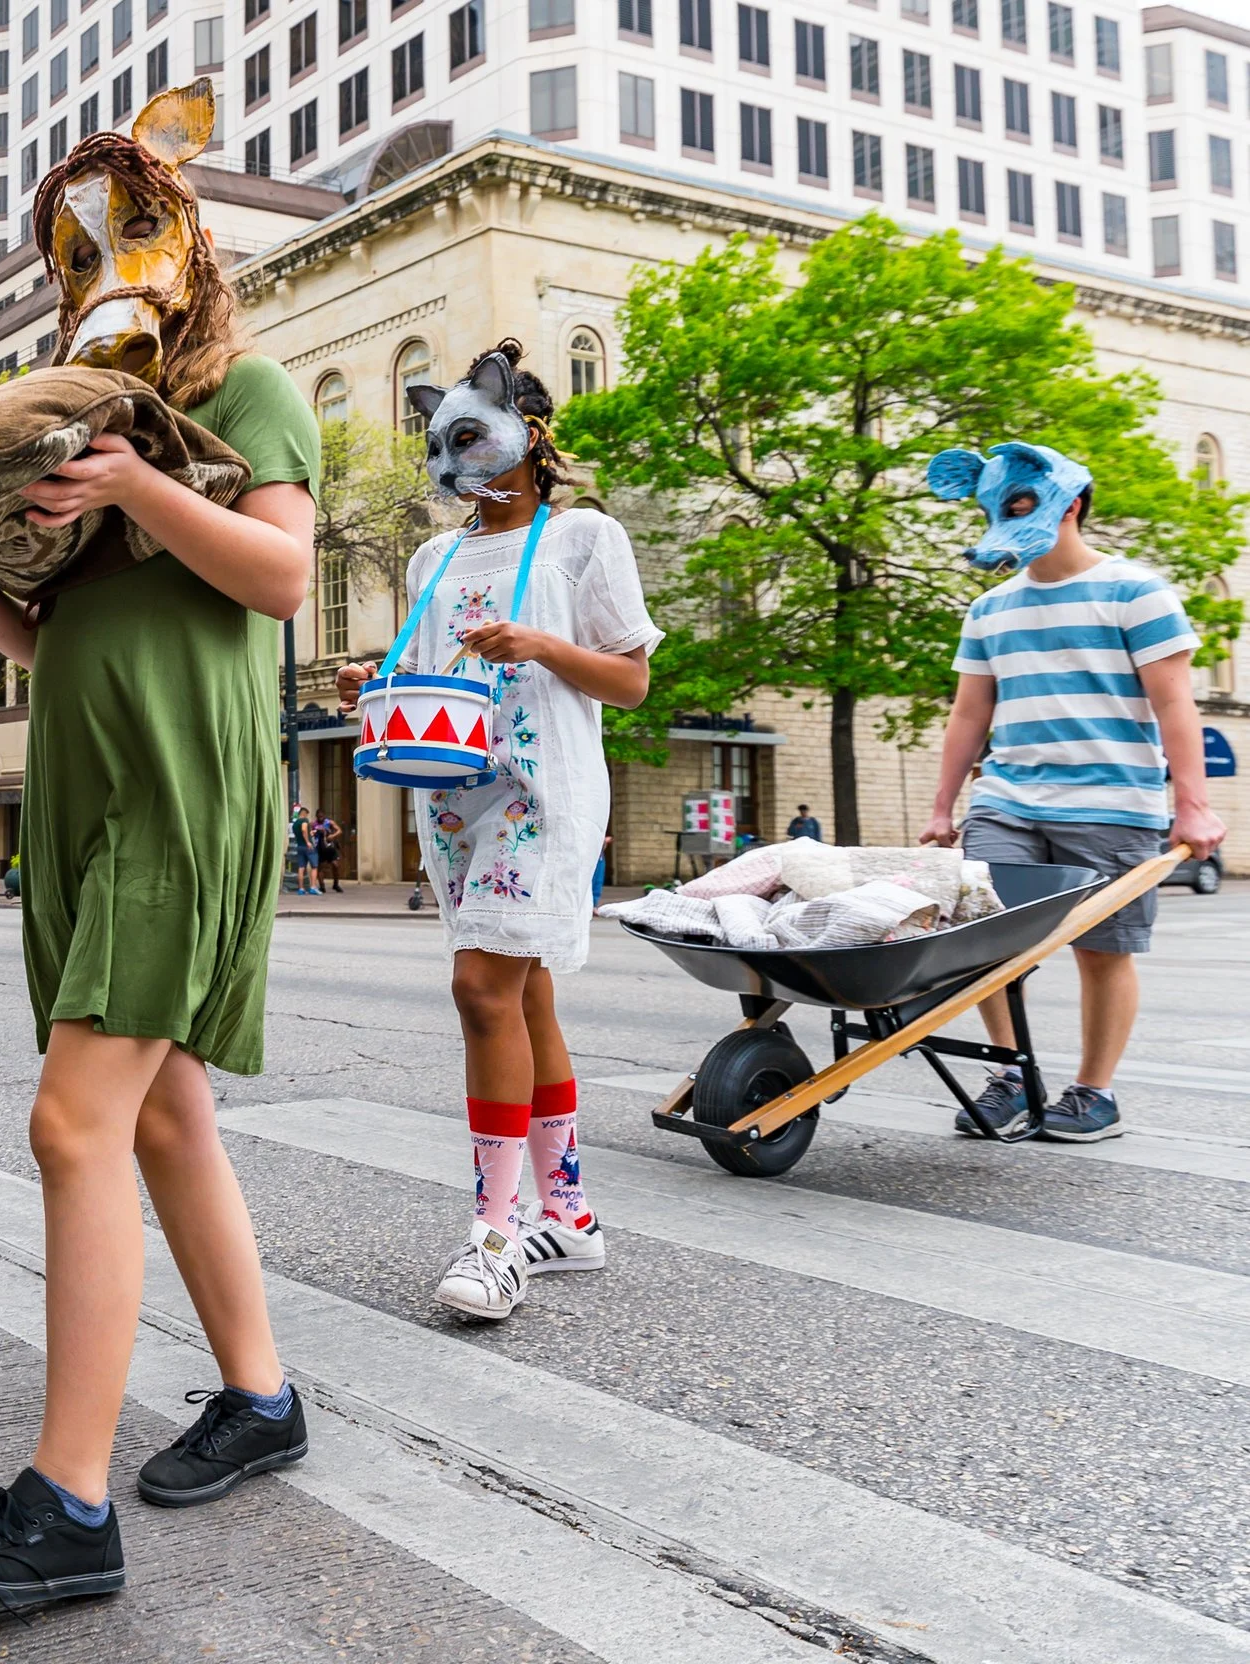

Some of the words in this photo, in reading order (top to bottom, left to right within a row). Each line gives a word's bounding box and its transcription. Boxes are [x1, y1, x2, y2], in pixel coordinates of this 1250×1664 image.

[542, 1119, 566, 1129] YOU
[473, 1137, 505, 1149] DON'T
[550, 1189, 584, 1201] GNOM
[566, 1201, 579, 1211] ME
